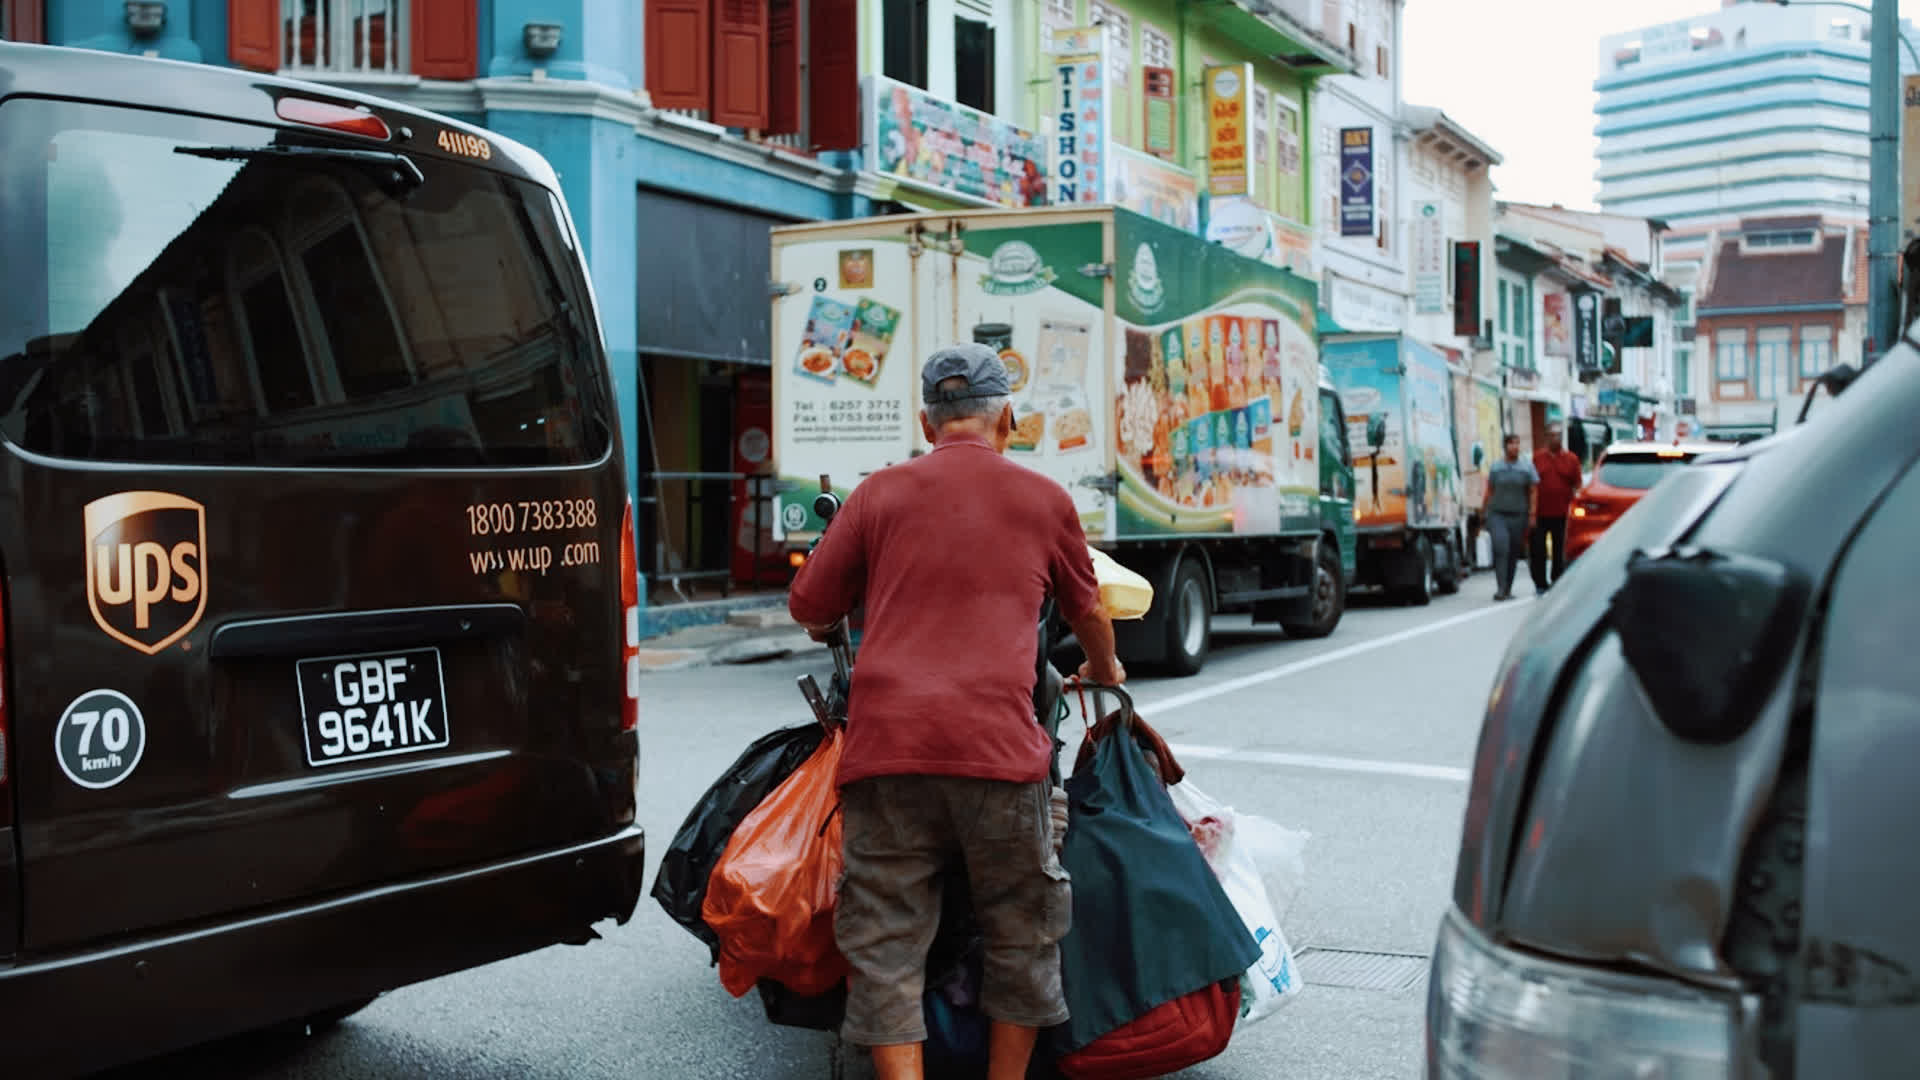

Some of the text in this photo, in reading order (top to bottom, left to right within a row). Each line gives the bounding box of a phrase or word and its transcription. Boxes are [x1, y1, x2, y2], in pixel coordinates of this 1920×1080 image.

[438, 130, 491, 160] 411199
[1058, 66, 1077, 202] TISHON
[793, 400, 814, 410] Tel
[829, 400, 863, 410] 6257
[867, 400, 900, 409] 3712
[793, 412, 816, 422] Fax
[466, 499, 598, 535] 1800 7383388
[96, 541, 200, 629] ups
[334, 657, 408, 706] GBF
[71, 707, 130, 756] 70
[318, 698, 437, 757] 9641K
[82, 753, 122, 771] km/h
